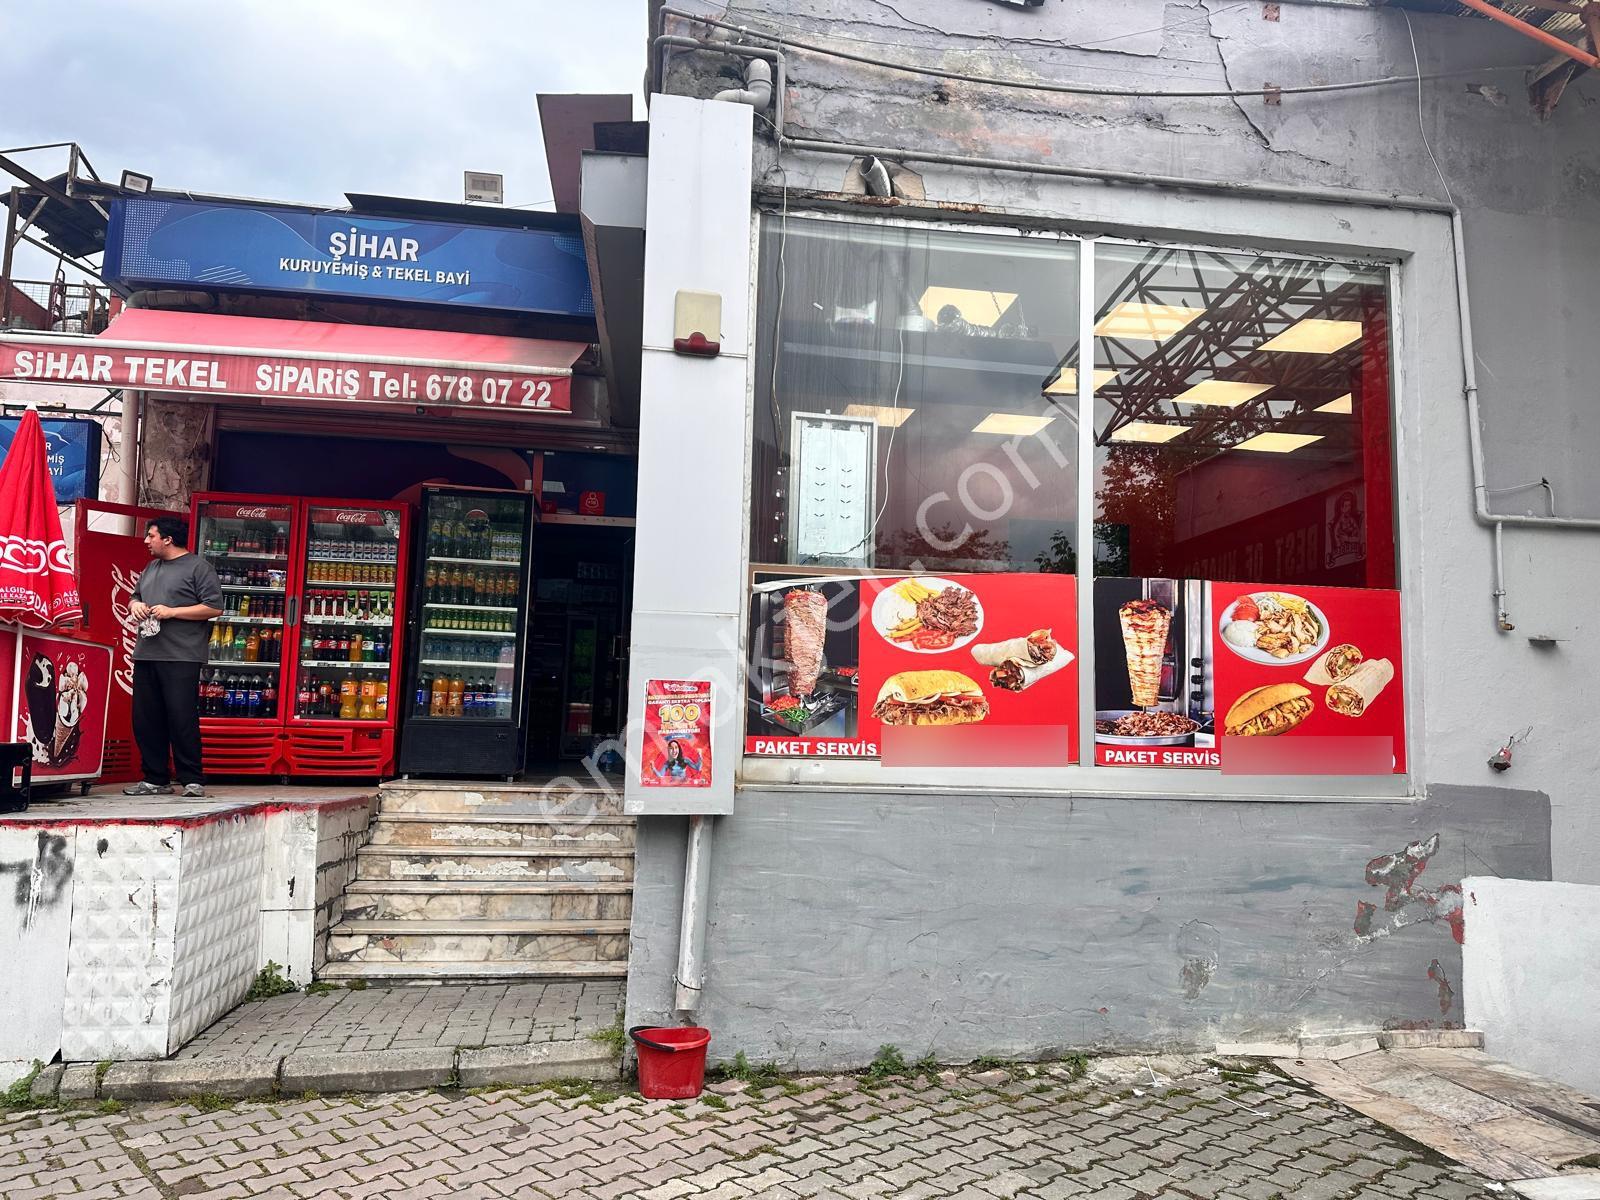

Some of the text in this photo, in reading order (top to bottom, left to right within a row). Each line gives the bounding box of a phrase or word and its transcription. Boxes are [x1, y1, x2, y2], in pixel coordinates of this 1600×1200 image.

[329, 227, 419, 261] ŞİHAR
[279, 257, 470, 286] KURUYEMİŞ & TEKEL BAYİ
[124, 356, 226, 389] TEKEL
[368, 370, 417, 399] Tel:
[426, 374, 474, 403] 678
[481, 377, 513, 404] 07
[520, 380, 552, 407] 22
[658, 704, 700, 722] 100
[755, 740, 877, 756] PAKET SERVİS
[1105, 750, 1220, 766] PAKET SERVİS
